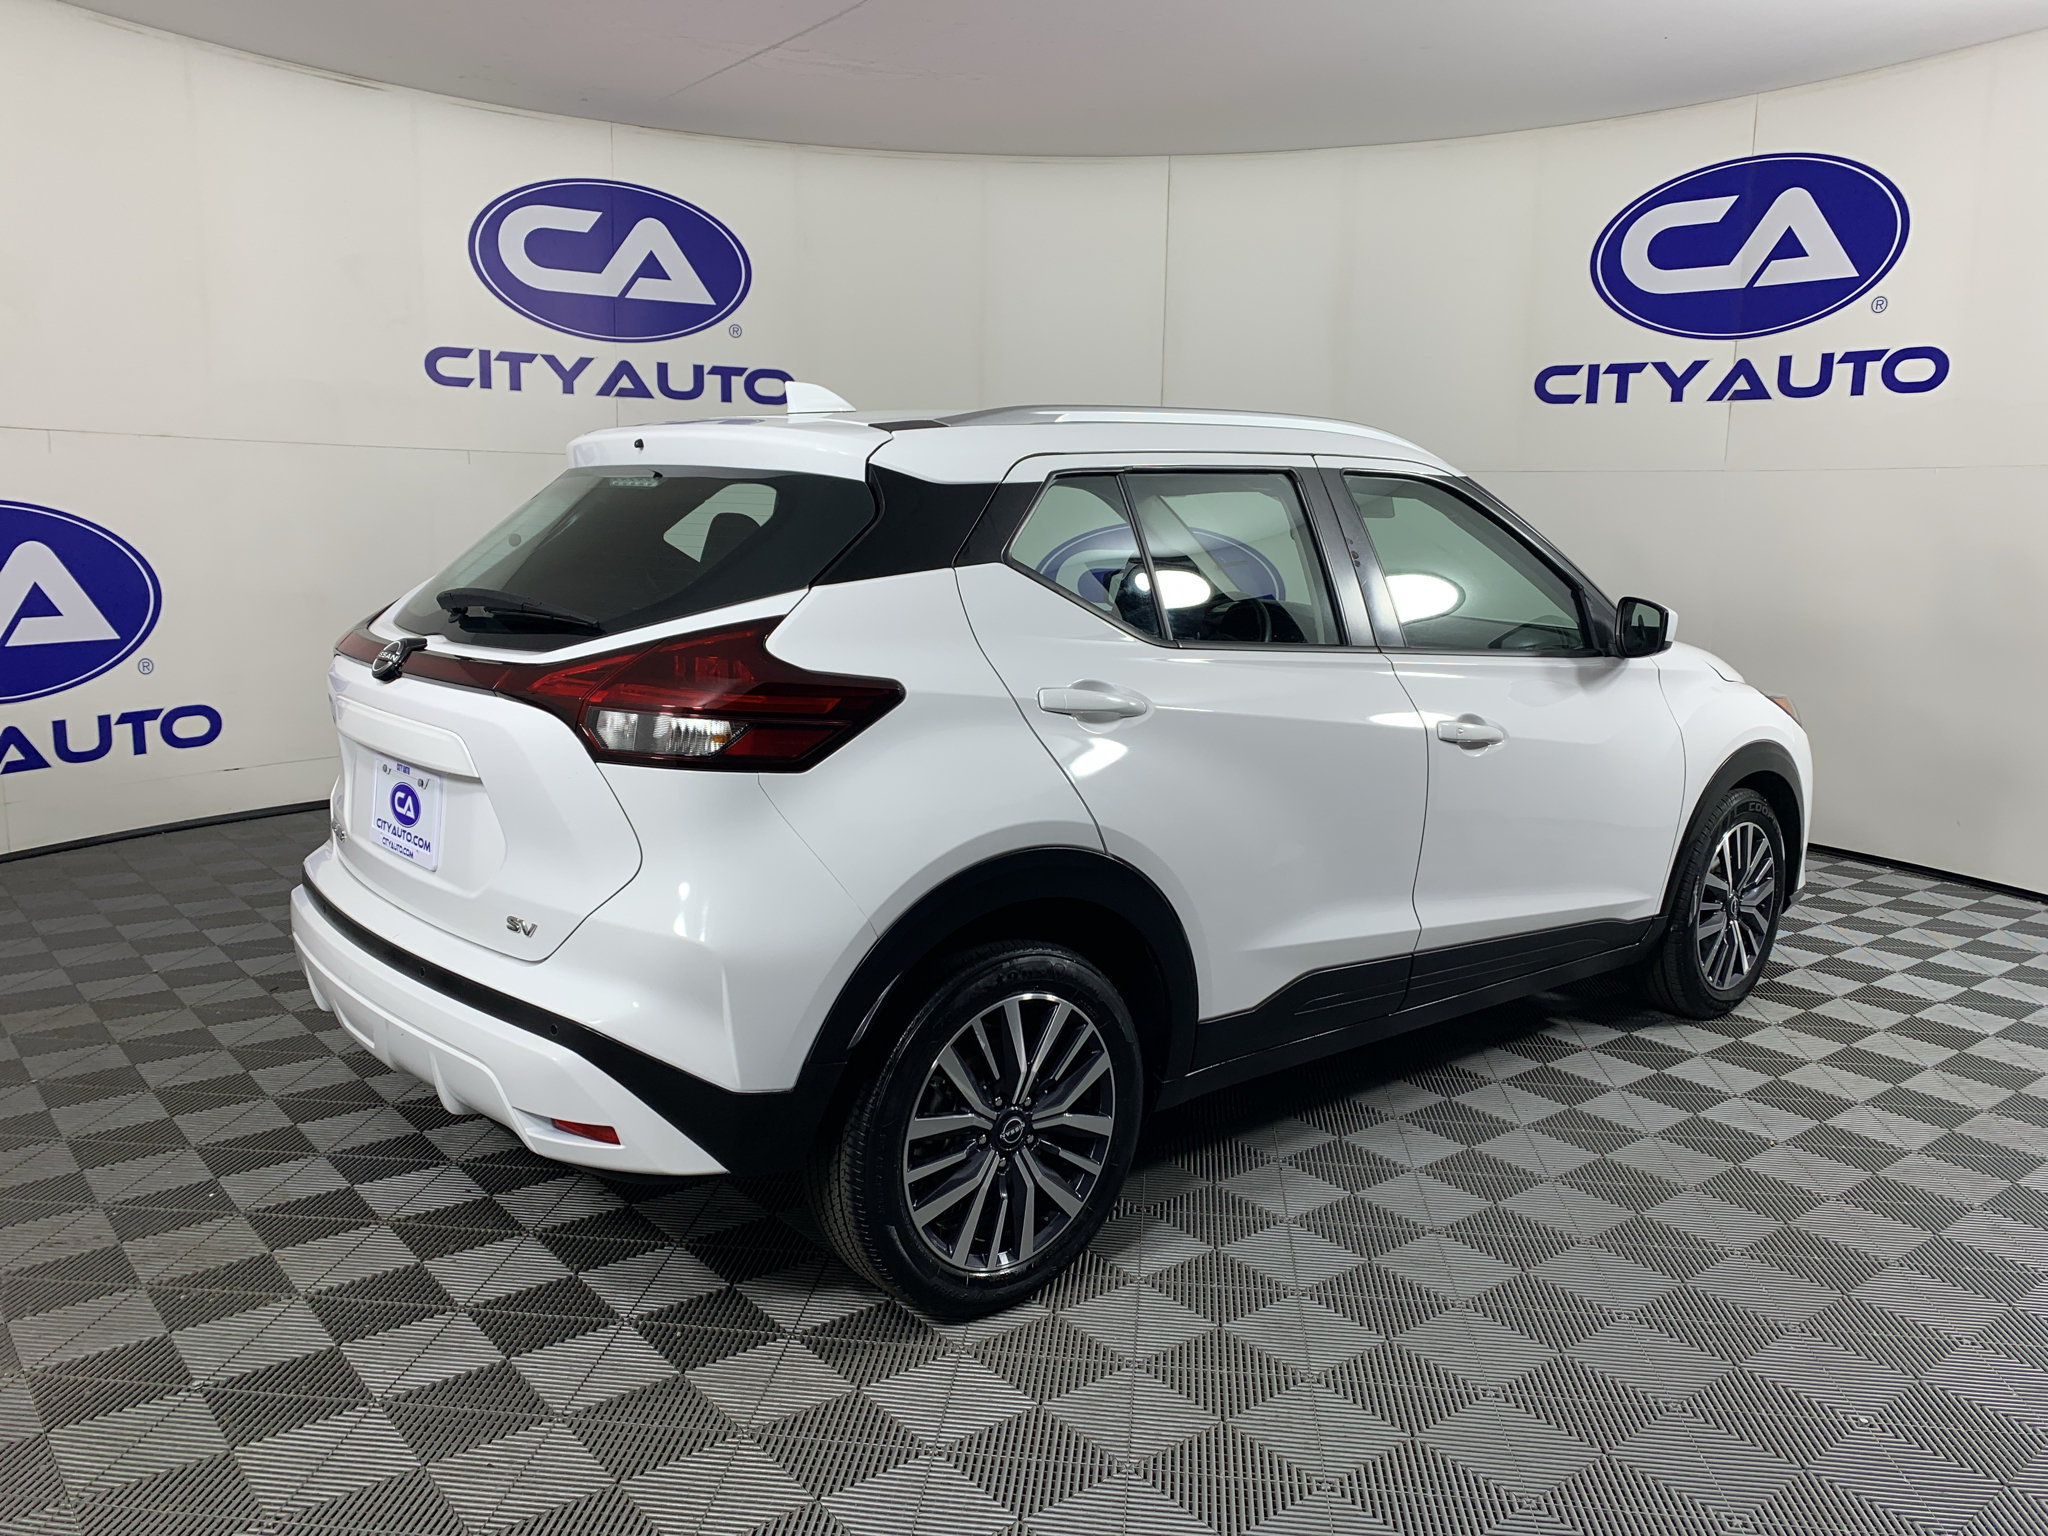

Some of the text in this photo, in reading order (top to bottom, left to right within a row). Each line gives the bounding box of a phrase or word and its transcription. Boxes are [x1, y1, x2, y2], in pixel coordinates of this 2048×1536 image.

[498, 204, 717, 305] CA
[1621, 187, 1860, 294] CA
[394, 790, 415, 820] CA
[506, 915, 538, 938] SV
